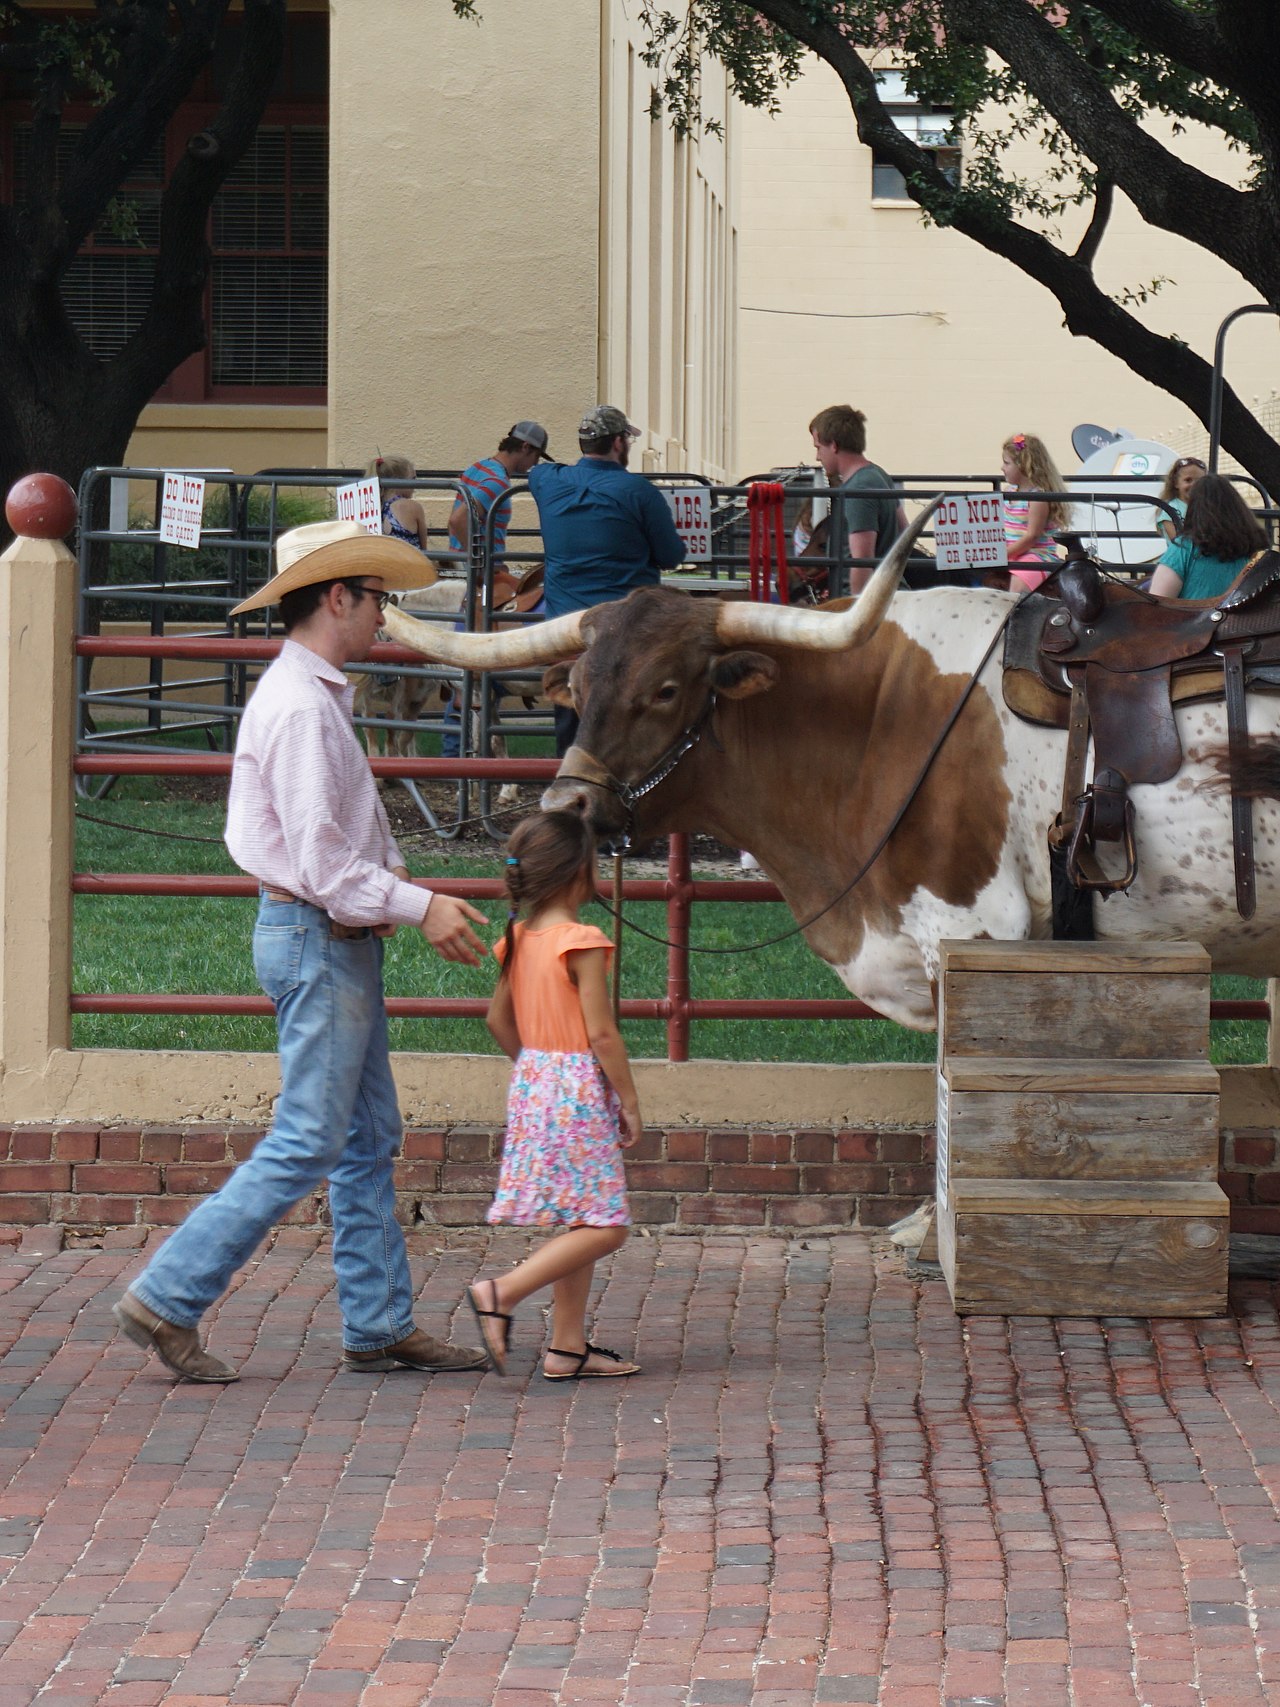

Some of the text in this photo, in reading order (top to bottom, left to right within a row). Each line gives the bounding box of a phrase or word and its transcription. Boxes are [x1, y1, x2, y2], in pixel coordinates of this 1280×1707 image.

[166, 478, 202, 506] DO NOT
[340, 485, 379, 521] 100 LBS.
[675, 496, 708, 529] LBS.
[937, 499, 1000, 526] DO NOT
[935, 528, 1007, 546] CLIMB ON PANELS
[946, 547, 998, 563] OR GATES
